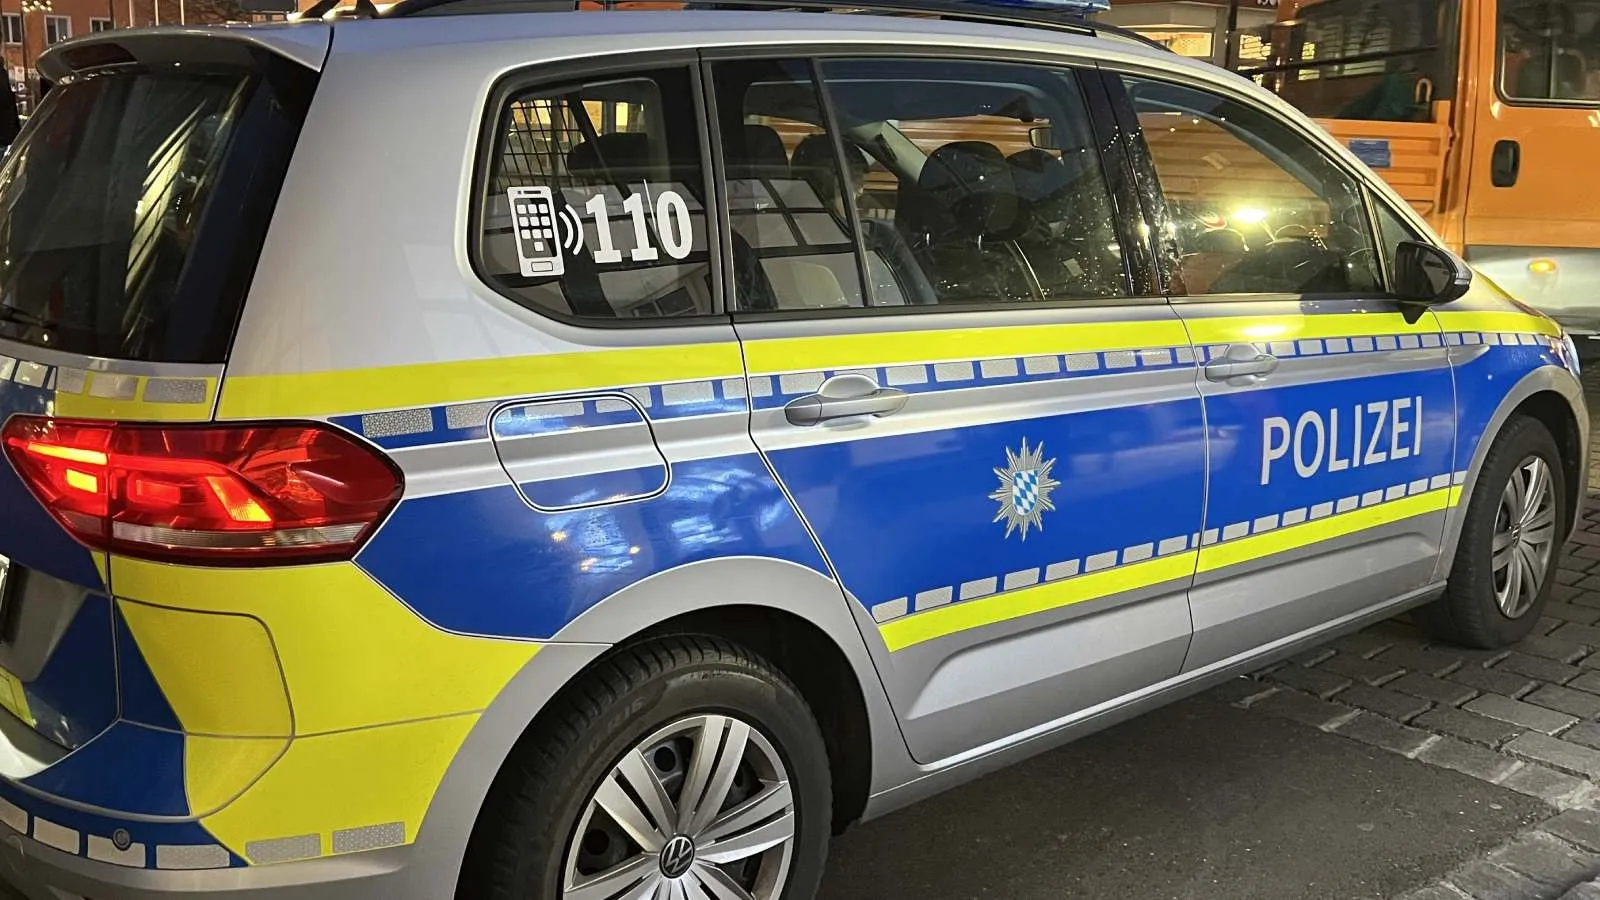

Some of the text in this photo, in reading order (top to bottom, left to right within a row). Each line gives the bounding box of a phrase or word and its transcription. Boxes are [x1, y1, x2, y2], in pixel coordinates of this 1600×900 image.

[585, 190, 692, 263] 110
[1261, 396, 1422, 485] POLIZEI
[662, 837, 693, 876] VW
